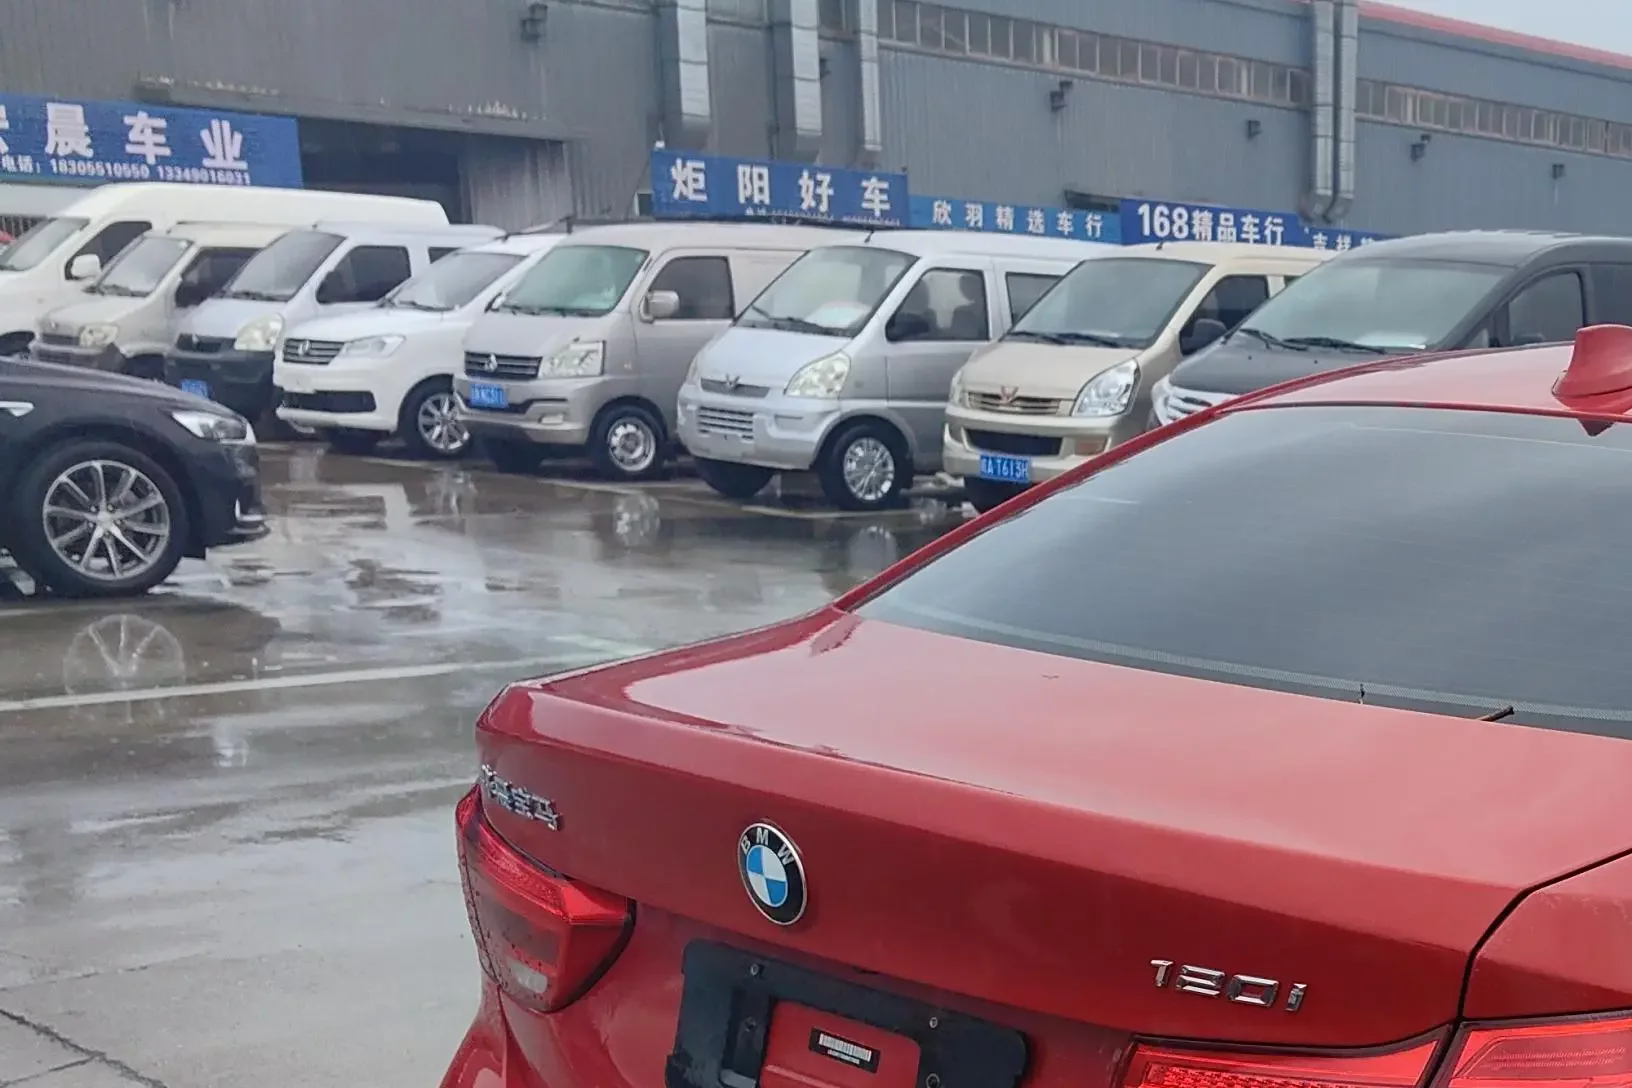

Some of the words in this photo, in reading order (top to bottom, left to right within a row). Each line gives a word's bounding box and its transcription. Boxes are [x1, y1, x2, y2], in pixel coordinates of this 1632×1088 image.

[0, 102, 248, 170] 晨车业
[671, 158, 891, 217] 炬阳好车
[932, 200, 1103, 238] 欣羽精选车行
[741, 827, 796, 866] BMW
[1150, 959, 1307, 1012] 120i
